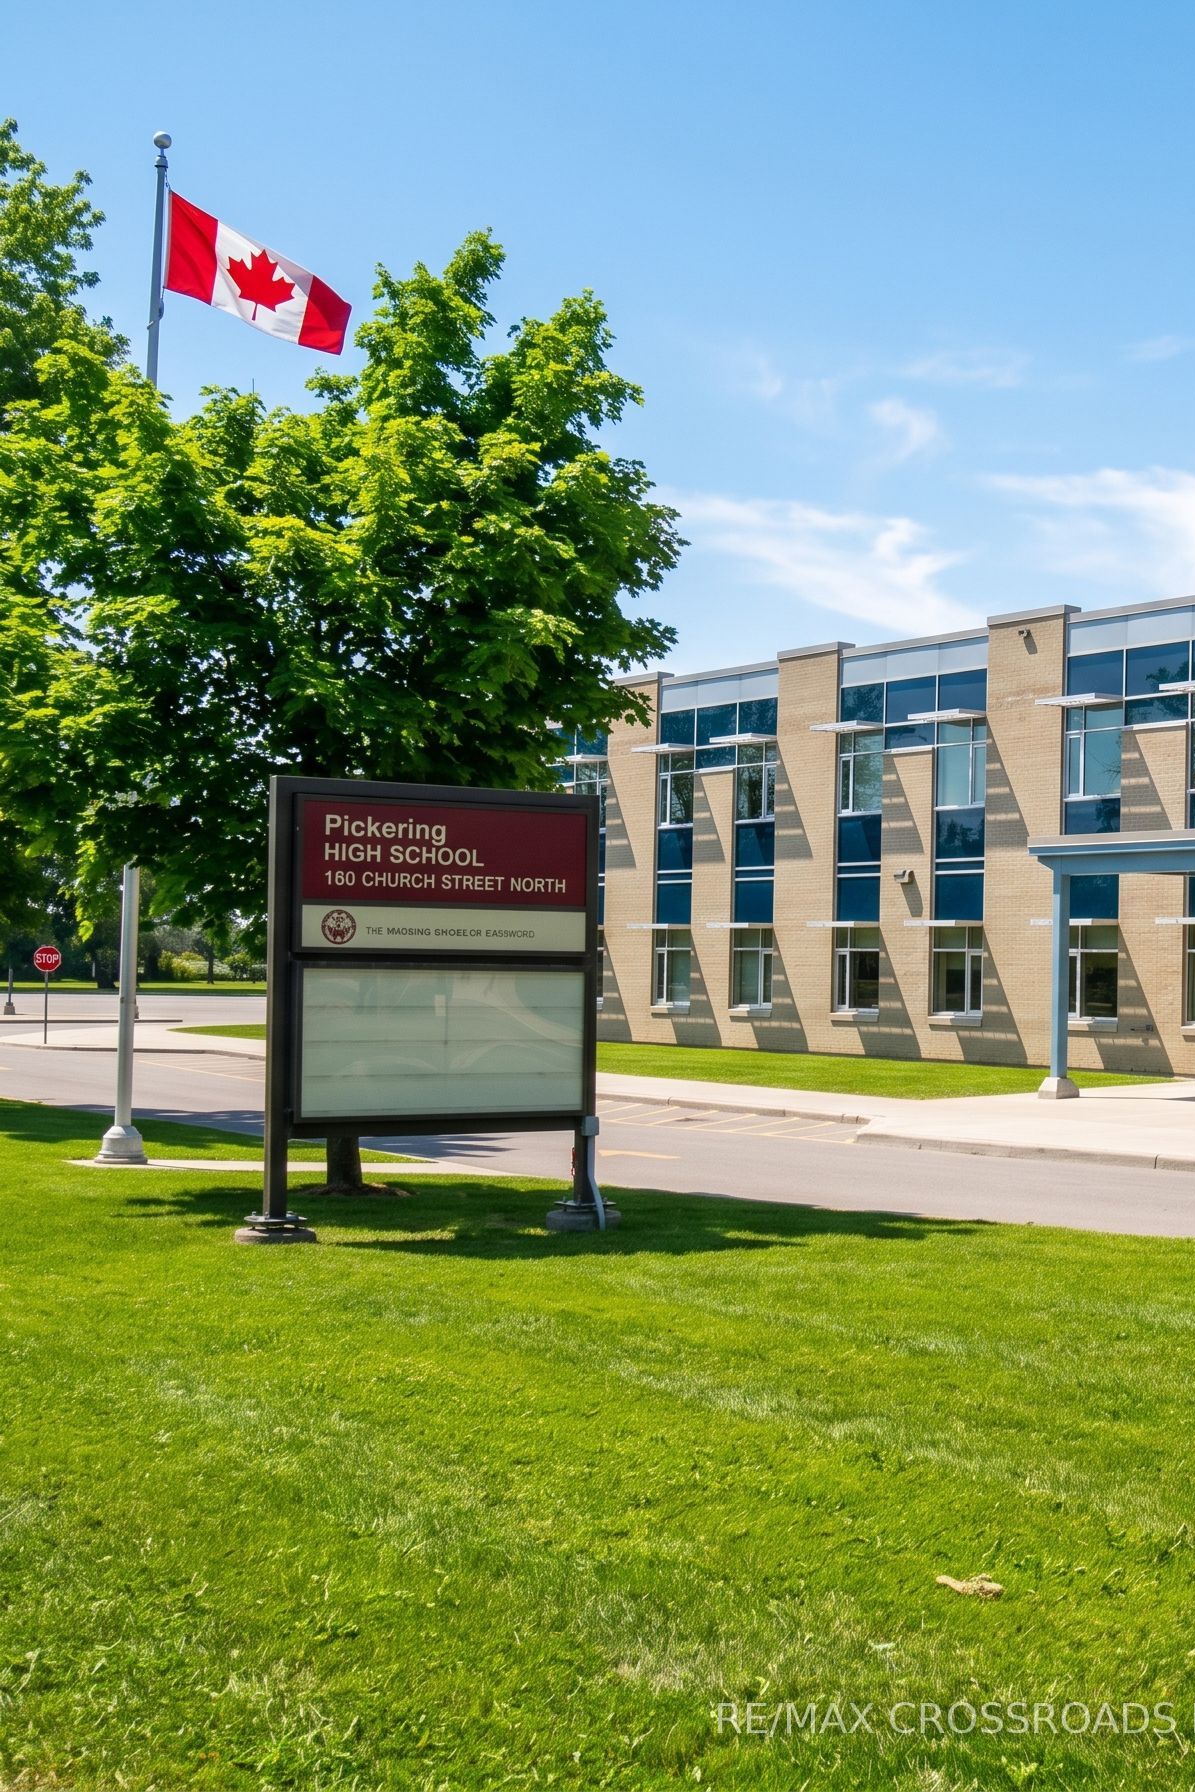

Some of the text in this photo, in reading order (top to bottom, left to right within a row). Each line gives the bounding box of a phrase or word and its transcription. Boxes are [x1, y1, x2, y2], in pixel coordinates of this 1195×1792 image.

[324, 814, 447, 846] Pickering
[323, 842, 485, 867] HIGH SCHOOL
[324, 870, 566, 893] 160 CHURCH STREET NORTH
[365, 926, 383, 936] THE
[36, 953, 59, 964] STOP
